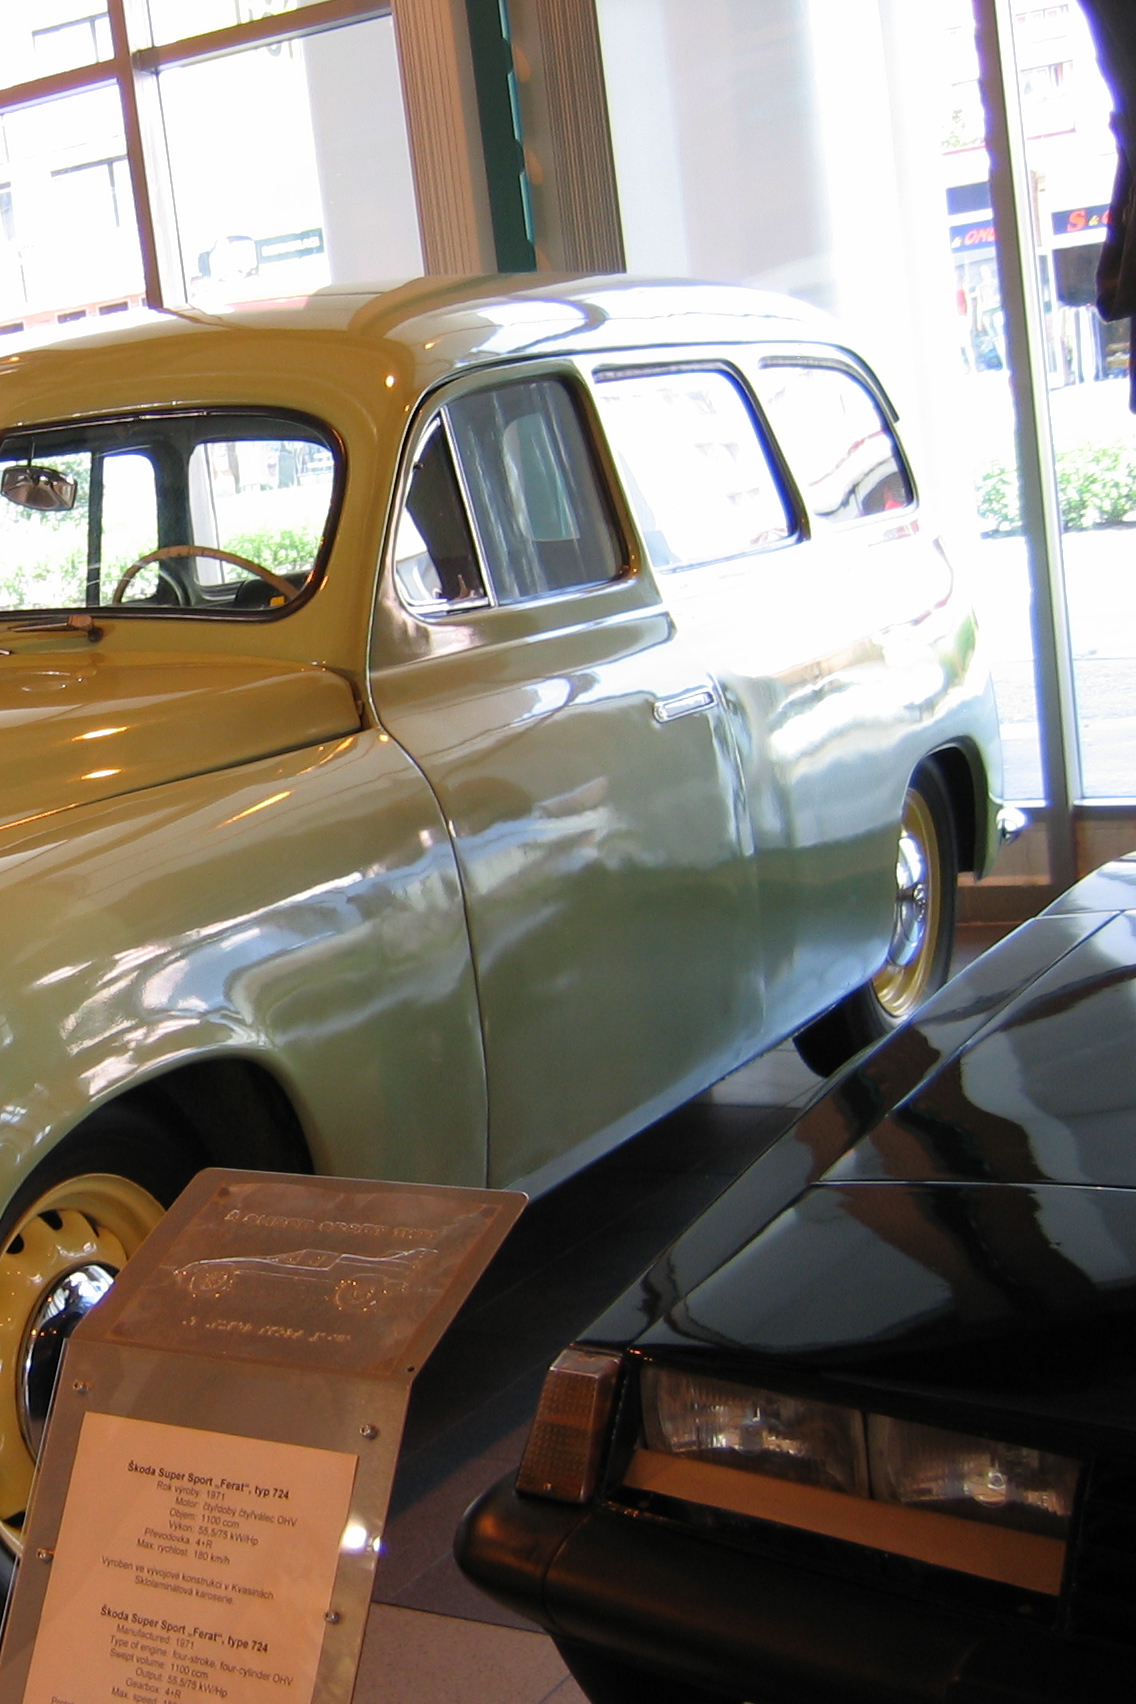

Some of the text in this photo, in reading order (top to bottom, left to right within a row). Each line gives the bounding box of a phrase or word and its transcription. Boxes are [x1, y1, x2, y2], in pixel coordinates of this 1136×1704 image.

[127, 1460, 156, 1477] Škoda
[158, 1467, 186, 1482] Super
[187, 1473, 213, 1486] Sport
[254, 1485, 271, 1499] typ
[272, 1488, 290, 1500] 724
[156, 1480, 172, 1492] Rok
[206, 1489, 225, 1501] 1971
[201, 1514, 221, 1526] 1100
[222, 1519, 240, 1529] ccm
[277, 1515, 298, 1527] OHV
[193, 1549, 209, 1561] 180
[100, 1604, 129, 1621] Škoda
[131, 1613, 159, 1628] Super
[160, 1619, 186, 1635] Sport
[227, 1636, 249, 1650] type
[251, 1640, 268, 1653] 724
[176, 1638, 194, 1650] 1971
[110, 1635, 129, 1648] Type
[130, 1640, 140, 1650] of
[272, 1673, 294, 1686] OHV
[110, 1648, 134, 1662] Swept
[170, 1663, 190, 1675] 1100
[191, 1668, 209, 1679] ccm
